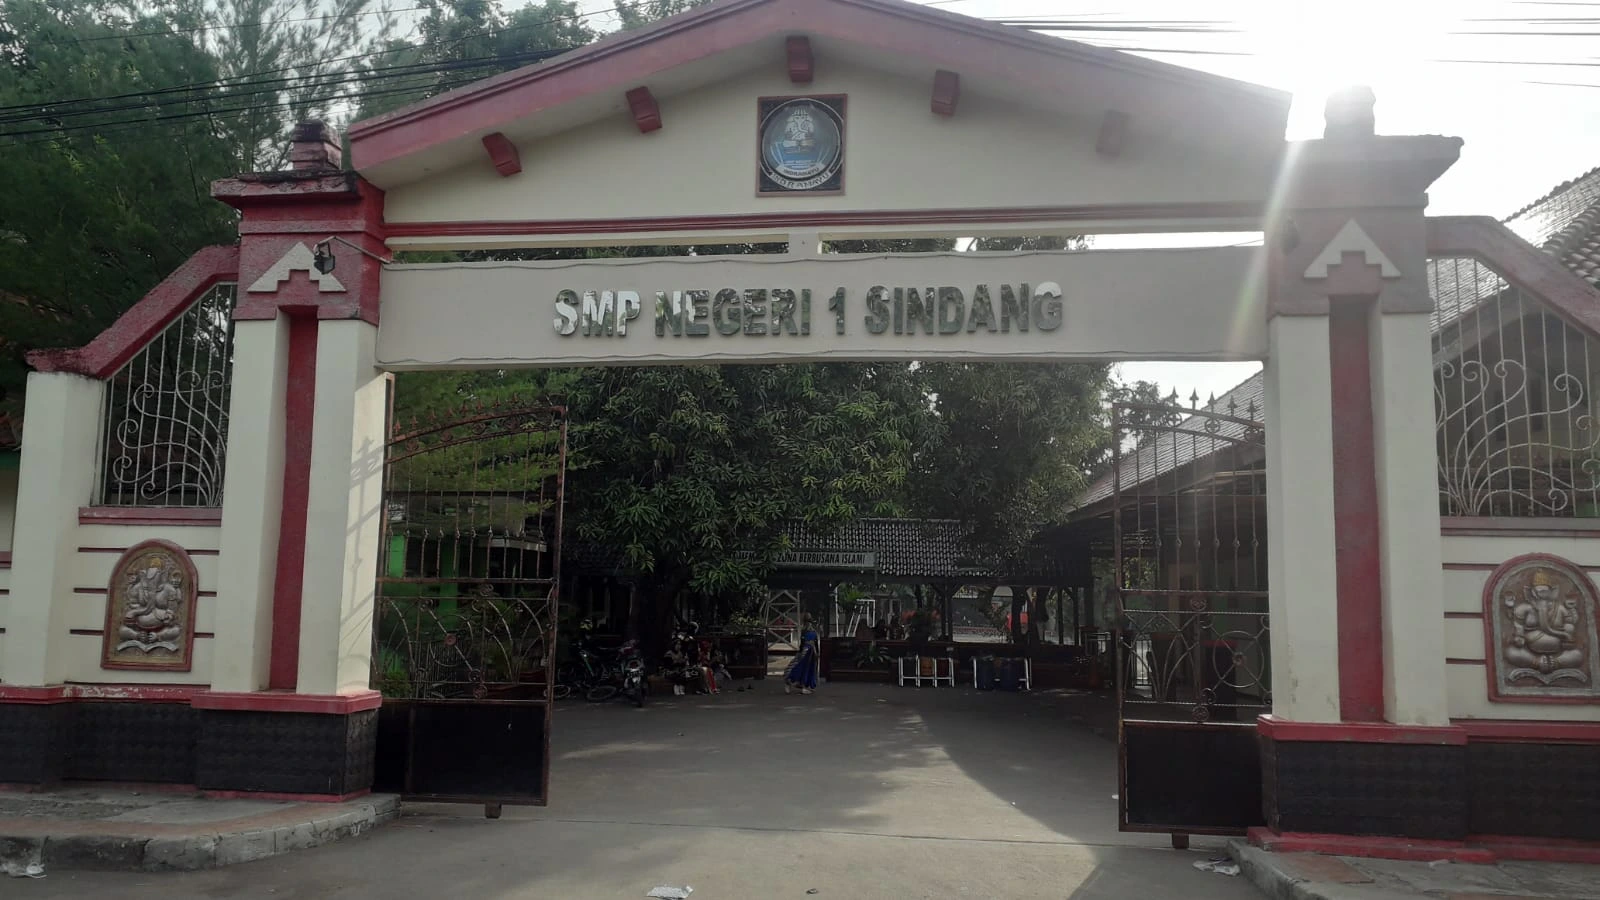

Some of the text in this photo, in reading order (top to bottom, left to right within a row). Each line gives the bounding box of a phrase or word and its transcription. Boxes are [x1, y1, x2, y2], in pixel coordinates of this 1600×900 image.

[553, 281, 1063, 336] SMP NEGERI 1 SINDANG
[777, 552, 866, 564] ZONA BERBUSANA ISLAMI
